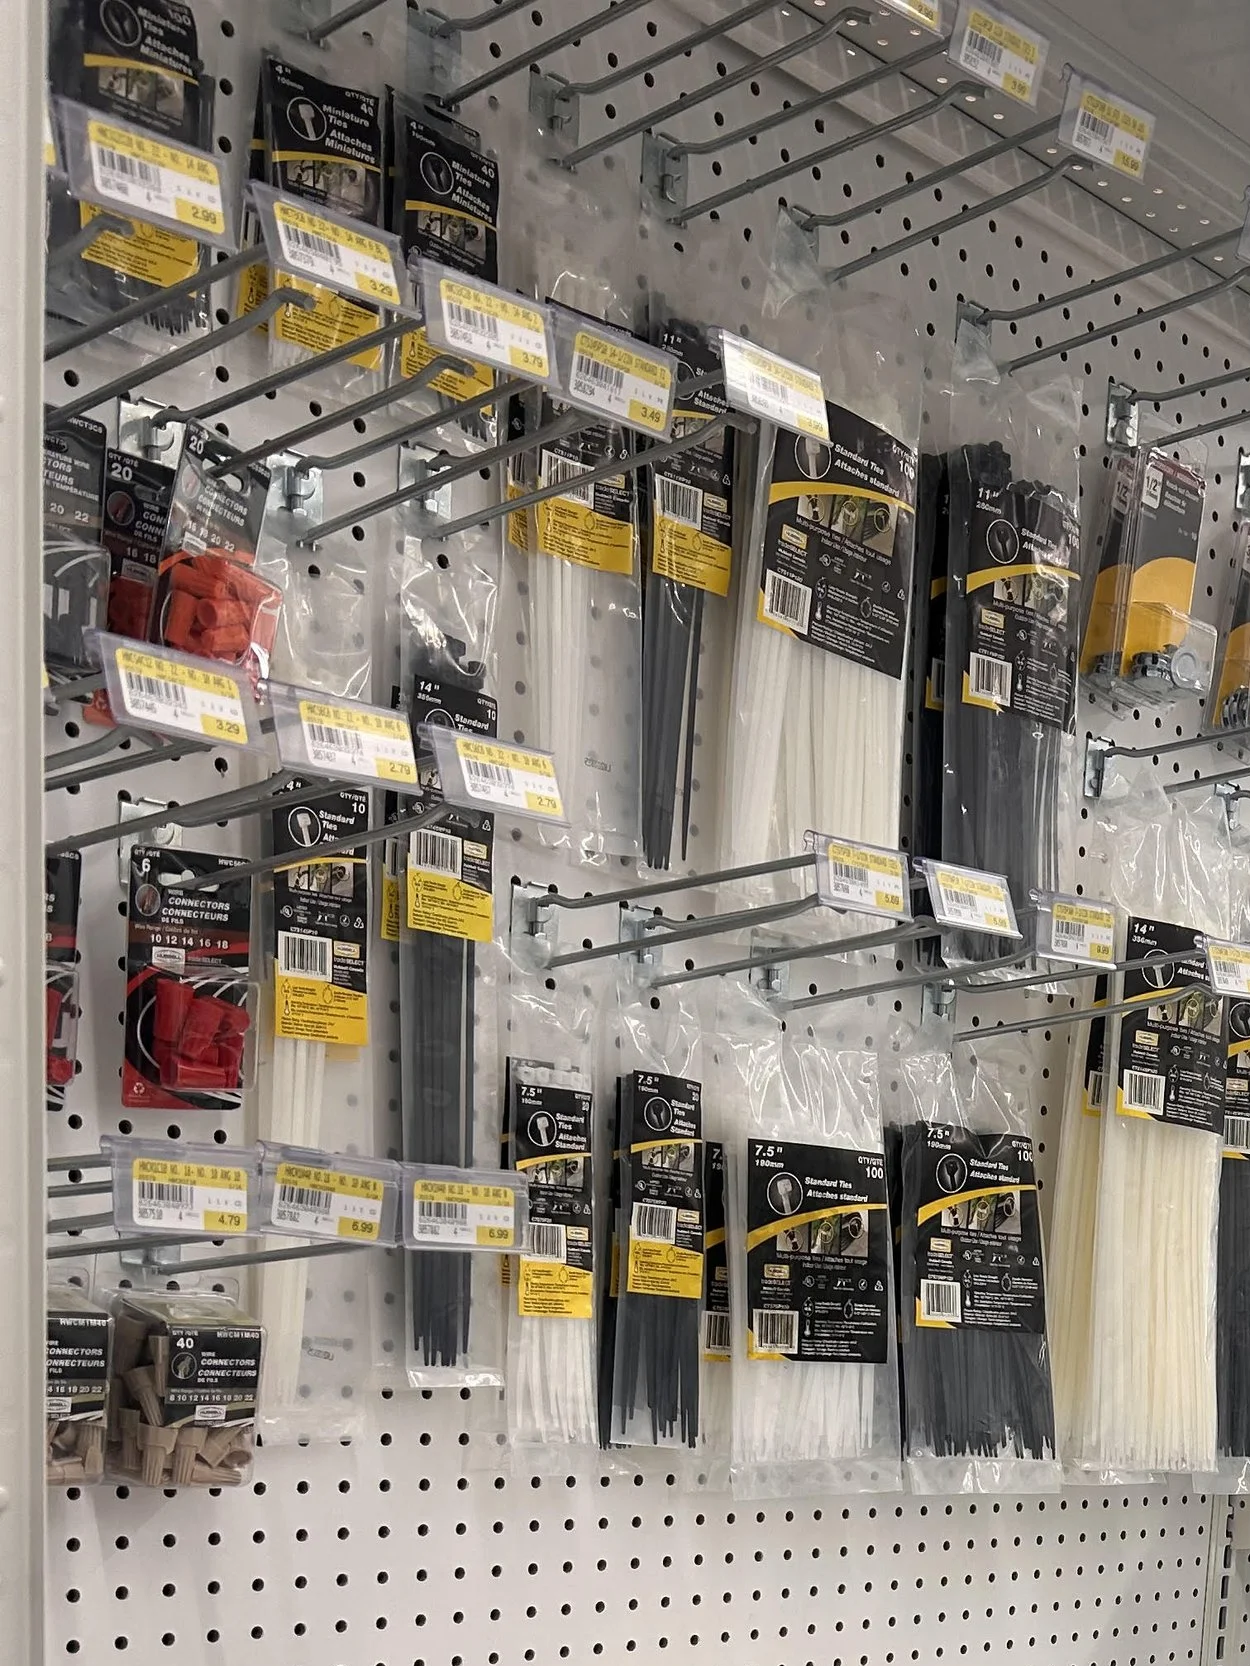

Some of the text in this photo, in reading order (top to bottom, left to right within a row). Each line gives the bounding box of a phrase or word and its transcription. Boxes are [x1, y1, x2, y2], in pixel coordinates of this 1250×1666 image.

[322, 104, 370, 127] Miniature
[328, 115, 348, 128] Ties
[329, 129, 373, 152] Attaches
[325, 137, 375, 164] Miniatures
[452, 161, 491, 188] Miniature
[455, 173, 473, 188] Ties
[456, 186, 490, 212] Attaches
[191, 206, 217, 224] 2.99
[452, 193, 493, 223] Miniatures
[522, 352, 543, 368] 3.79
[641, 406, 660, 423] 3.49
[188, 436, 204, 455] 20
[834, 444, 885, 475] Standard Ties
[111, 463, 133, 481] 20
[834, 459, 900, 497] Attaches standard
[216, 720, 240, 735] 3.29
[454, 713, 490, 731] Standard
[388, 762, 411, 776] 2.79
[351, 801, 366, 814] 10
[537, 796, 558, 809] 2.79
[318, 810, 356, 826] Standard
[321, 820, 339, 831] Ties
[142, 858, 151, 872] 6
[168, 897, 230, 911] CONNECTORS
[162, 908, 229, 921] CONNECTEURS
[1134, 923, 1154, 935] 14"
[150, 934, 229, 949] 10 12 14 16 18
[521, 1086, 543, 1097] 7.5"
[927, 1128, 950, 1139] 7.5"
[555, 1140, 585, 1150] Standard
[754, 1145, 783, 1157] 7.5"
[755, 1159, 784, 1169] 190mm
[970, 1158, 997, 1170] Standard
[865, 1167, 884, 1179] 100
[970, 1169, 997, 1180] Attaches
[804, 1176, 852, 1189] Standard Ties
[806, 1188, 869, 1202] Attaches standard
[218, 1215, 241, 1226] 4.79
[351, 1220, 374, 1234] 6.99
[488, 1228, 510, 1239] 6.99
[176, 1337, 194, 1349] 40
[201, 1358, 256, 1366] CONNECTORS
[197, 1369, 257, 1377] CONNECTEURS
